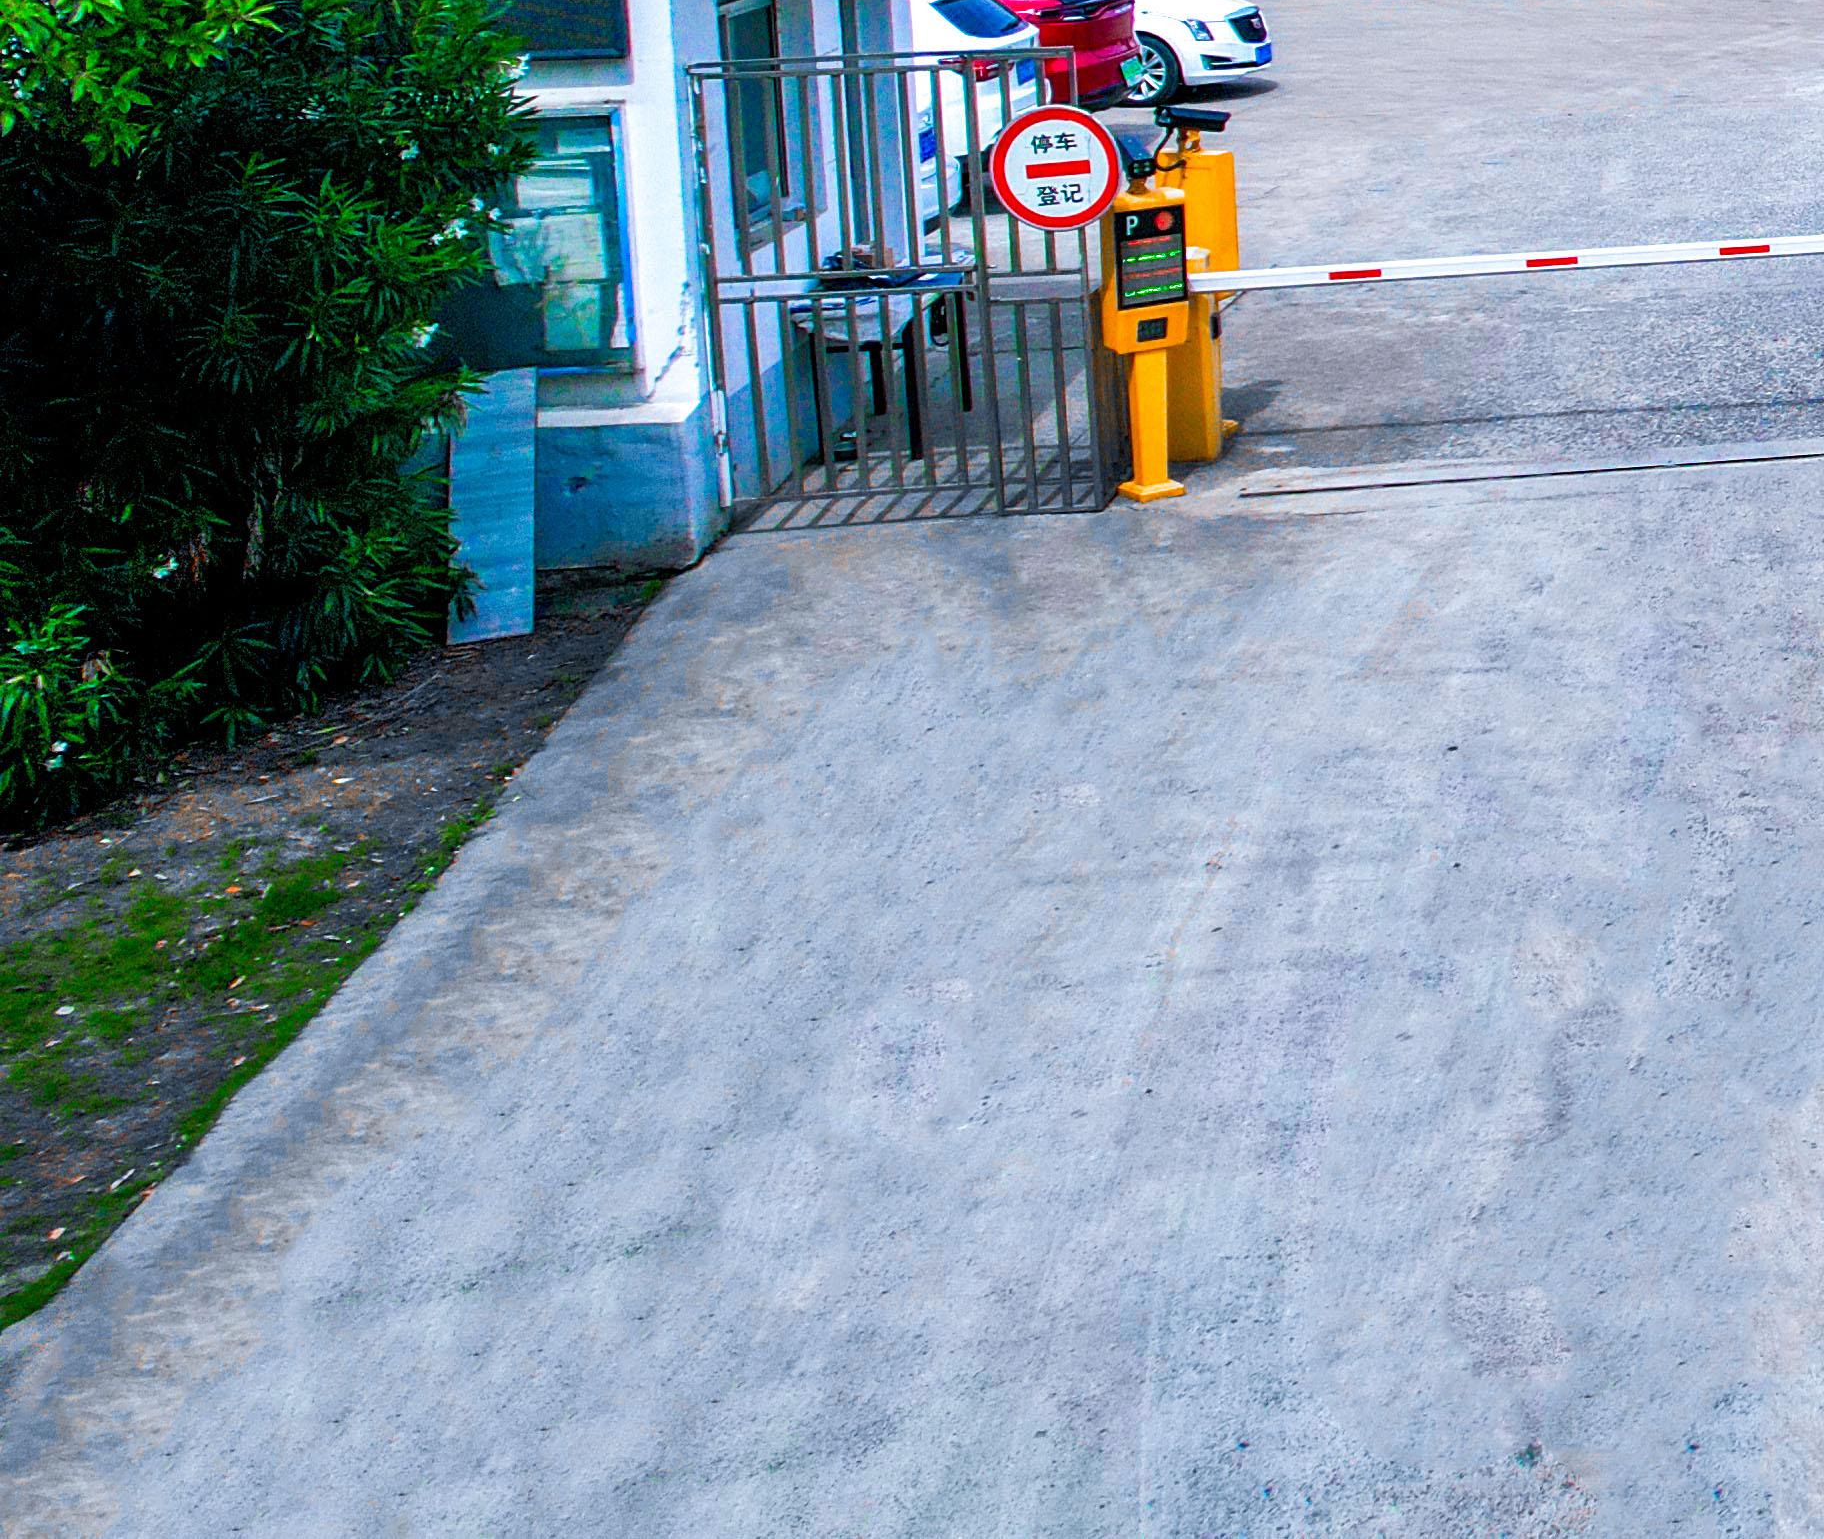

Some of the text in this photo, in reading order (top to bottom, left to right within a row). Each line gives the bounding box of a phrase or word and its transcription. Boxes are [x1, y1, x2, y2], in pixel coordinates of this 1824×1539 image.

[1031, 133, 1077, 154] 停车
[1037, 184, 1084, 206] 登记
[1126, 215, 1139, 236] P
